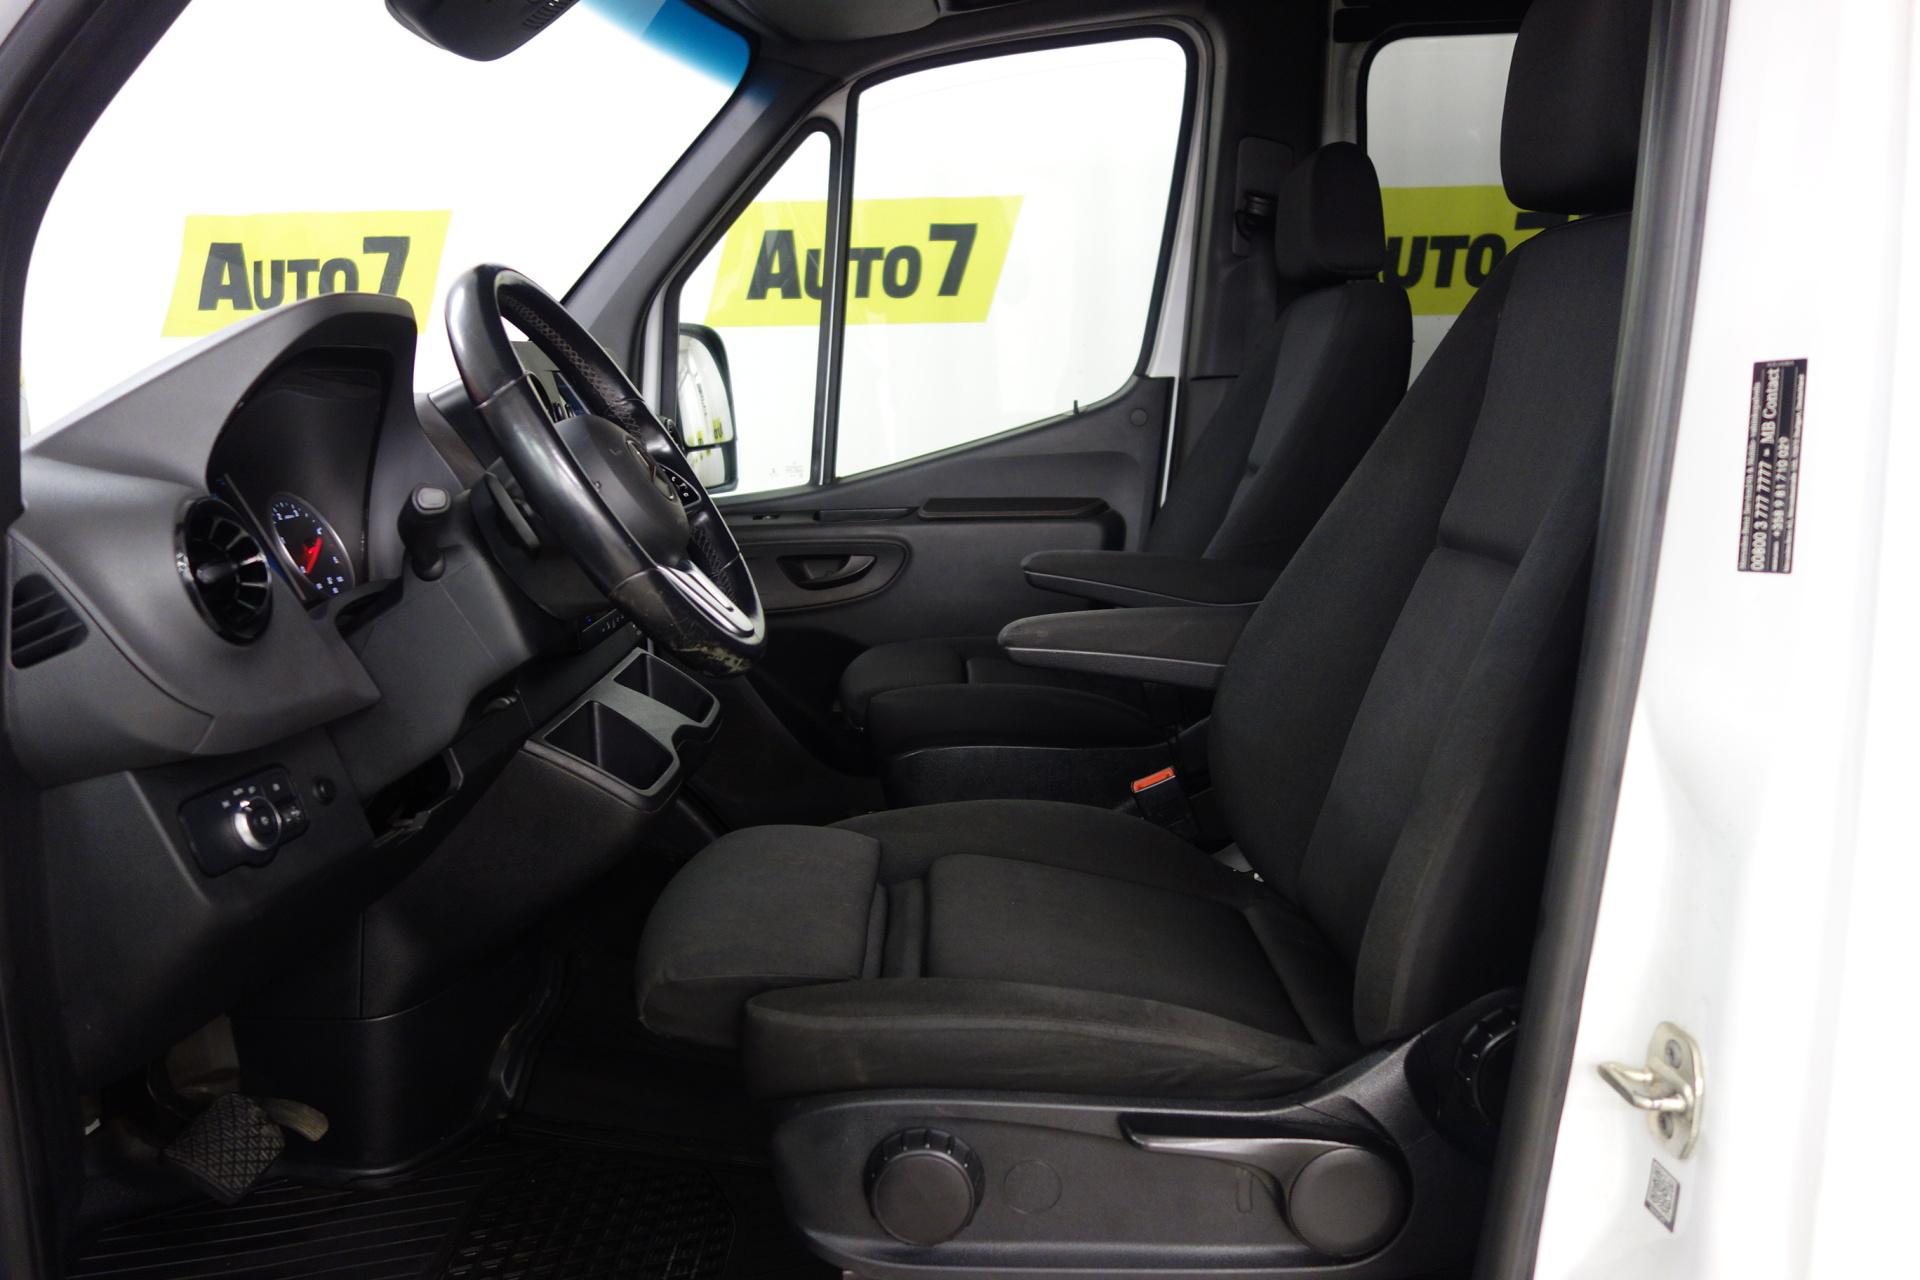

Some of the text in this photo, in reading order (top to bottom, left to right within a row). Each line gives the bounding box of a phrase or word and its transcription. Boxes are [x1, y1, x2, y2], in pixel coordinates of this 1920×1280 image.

[1762, 368, 1780, 419] Contact
[1760, 420, 1776, 444] MB
[1754, 494, 1770, 518] 777
